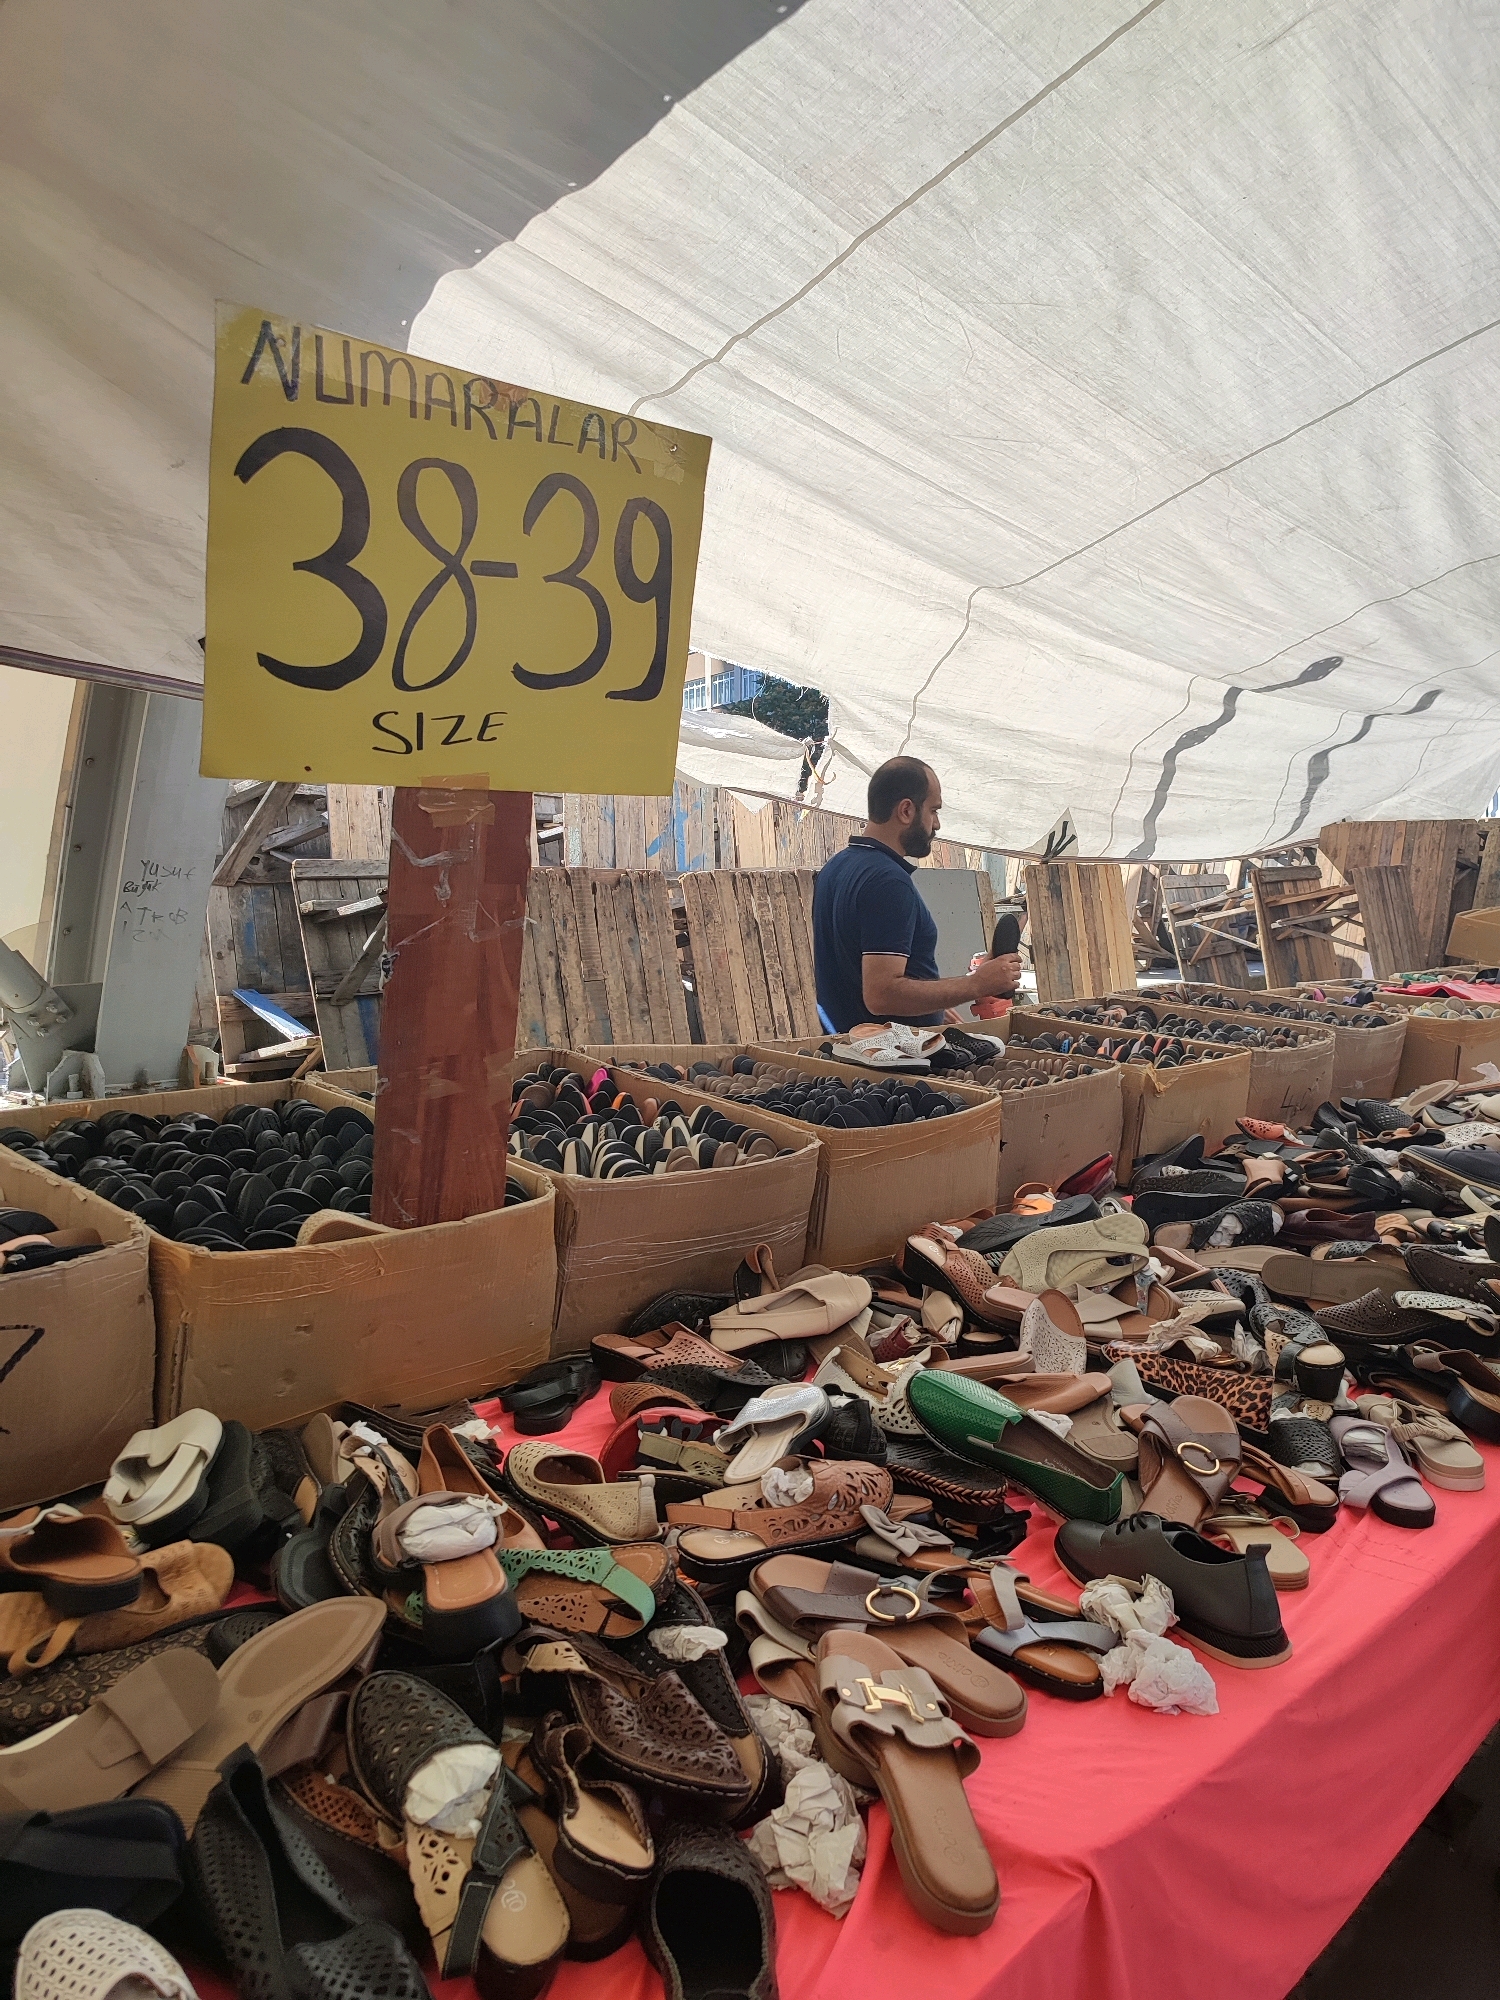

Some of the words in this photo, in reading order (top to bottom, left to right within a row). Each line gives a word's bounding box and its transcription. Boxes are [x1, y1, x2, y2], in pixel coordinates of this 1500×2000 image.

[240, 319, 642, 474] NUMARALAR
[233, 426, 674, 702] 38-39
[372, 711, 509, 754] SIZE
